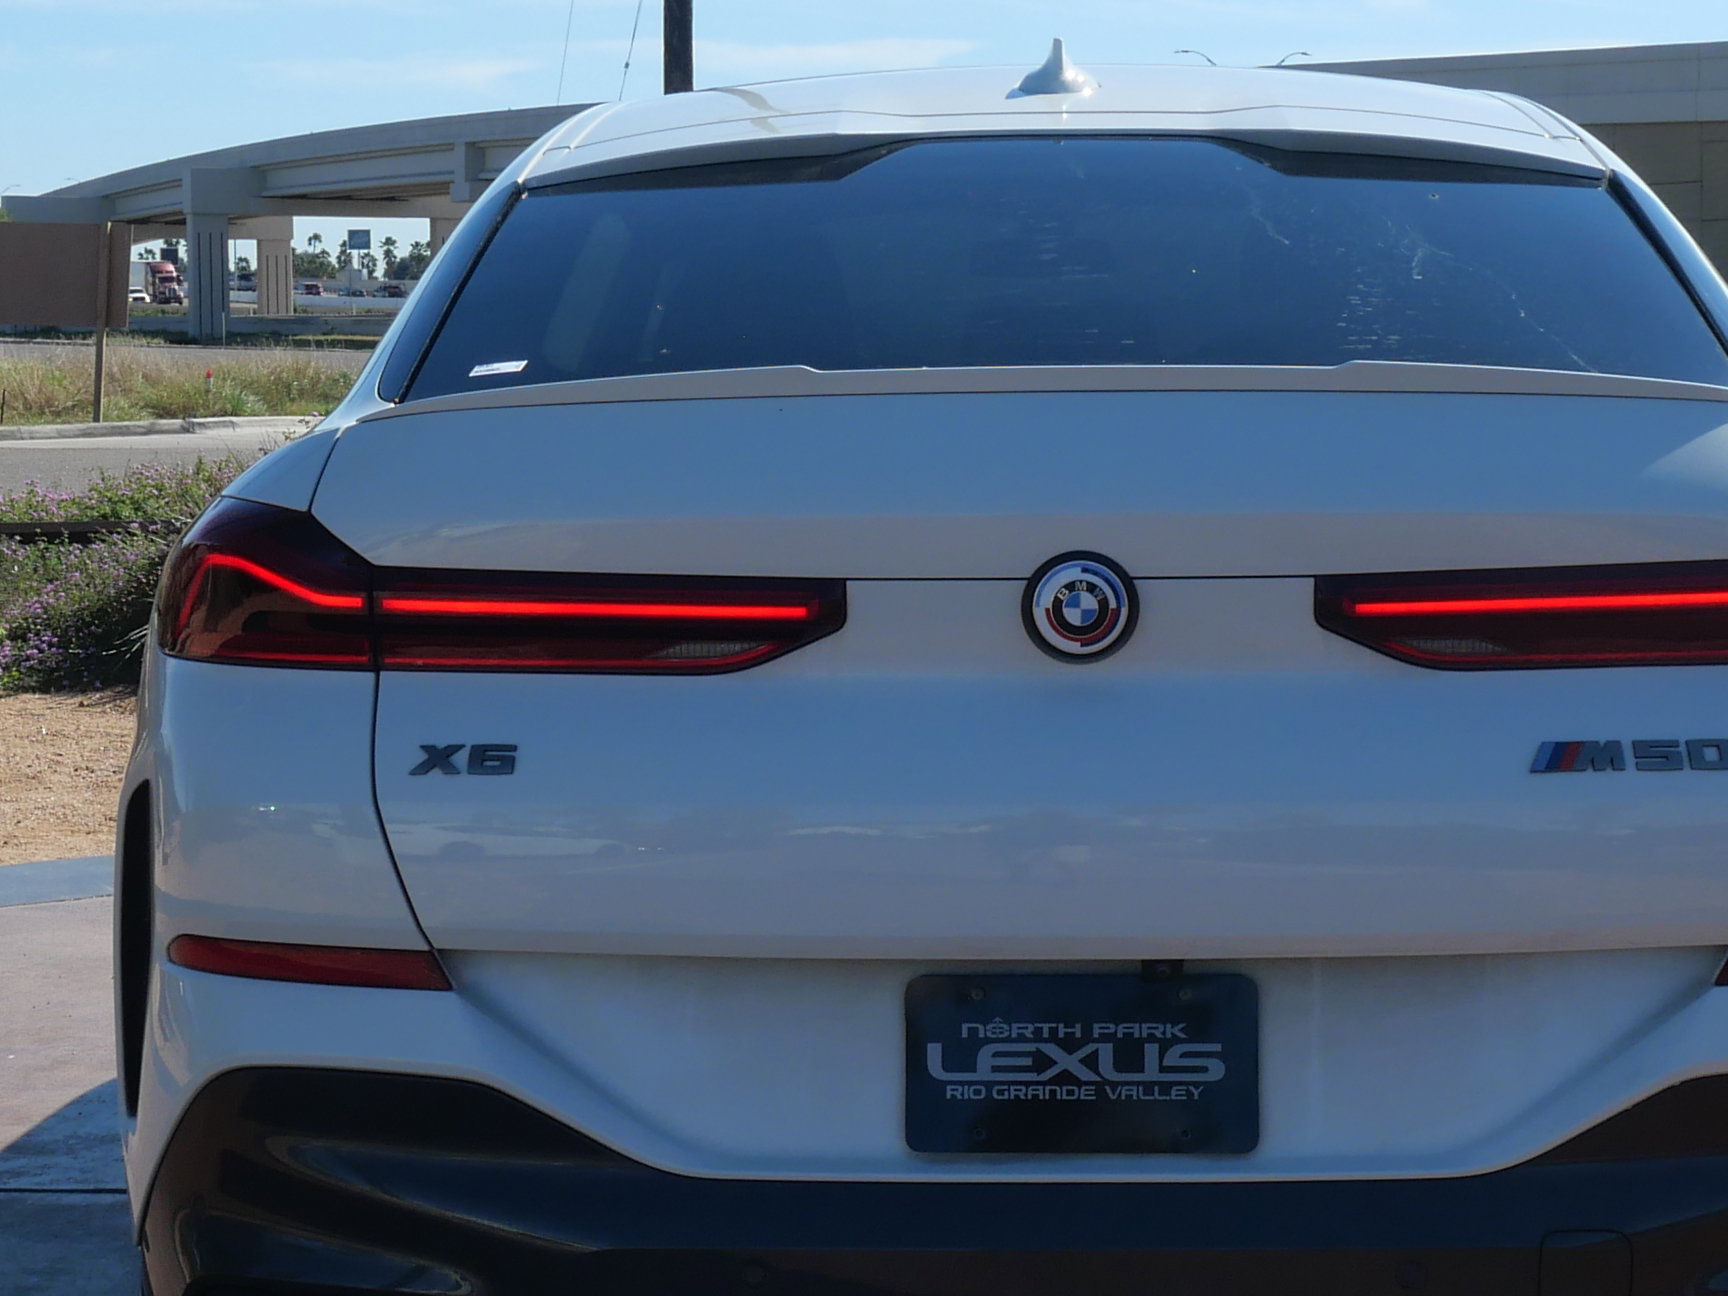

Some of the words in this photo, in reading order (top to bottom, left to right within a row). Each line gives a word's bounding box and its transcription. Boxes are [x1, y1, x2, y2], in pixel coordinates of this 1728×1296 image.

[1056, 580, 1106, 601] BMW
[408, 744, 518, 775] X6
[1093, 1023, 1188, 1039] PARK
[927, 1042, 1226, 1082] LEXUS
[946, 1085, 986, 1100] RIO
[992, 1085, 1097, 1100] GRANDE
[1104, 1085, 1204, 1100] VALLEY
